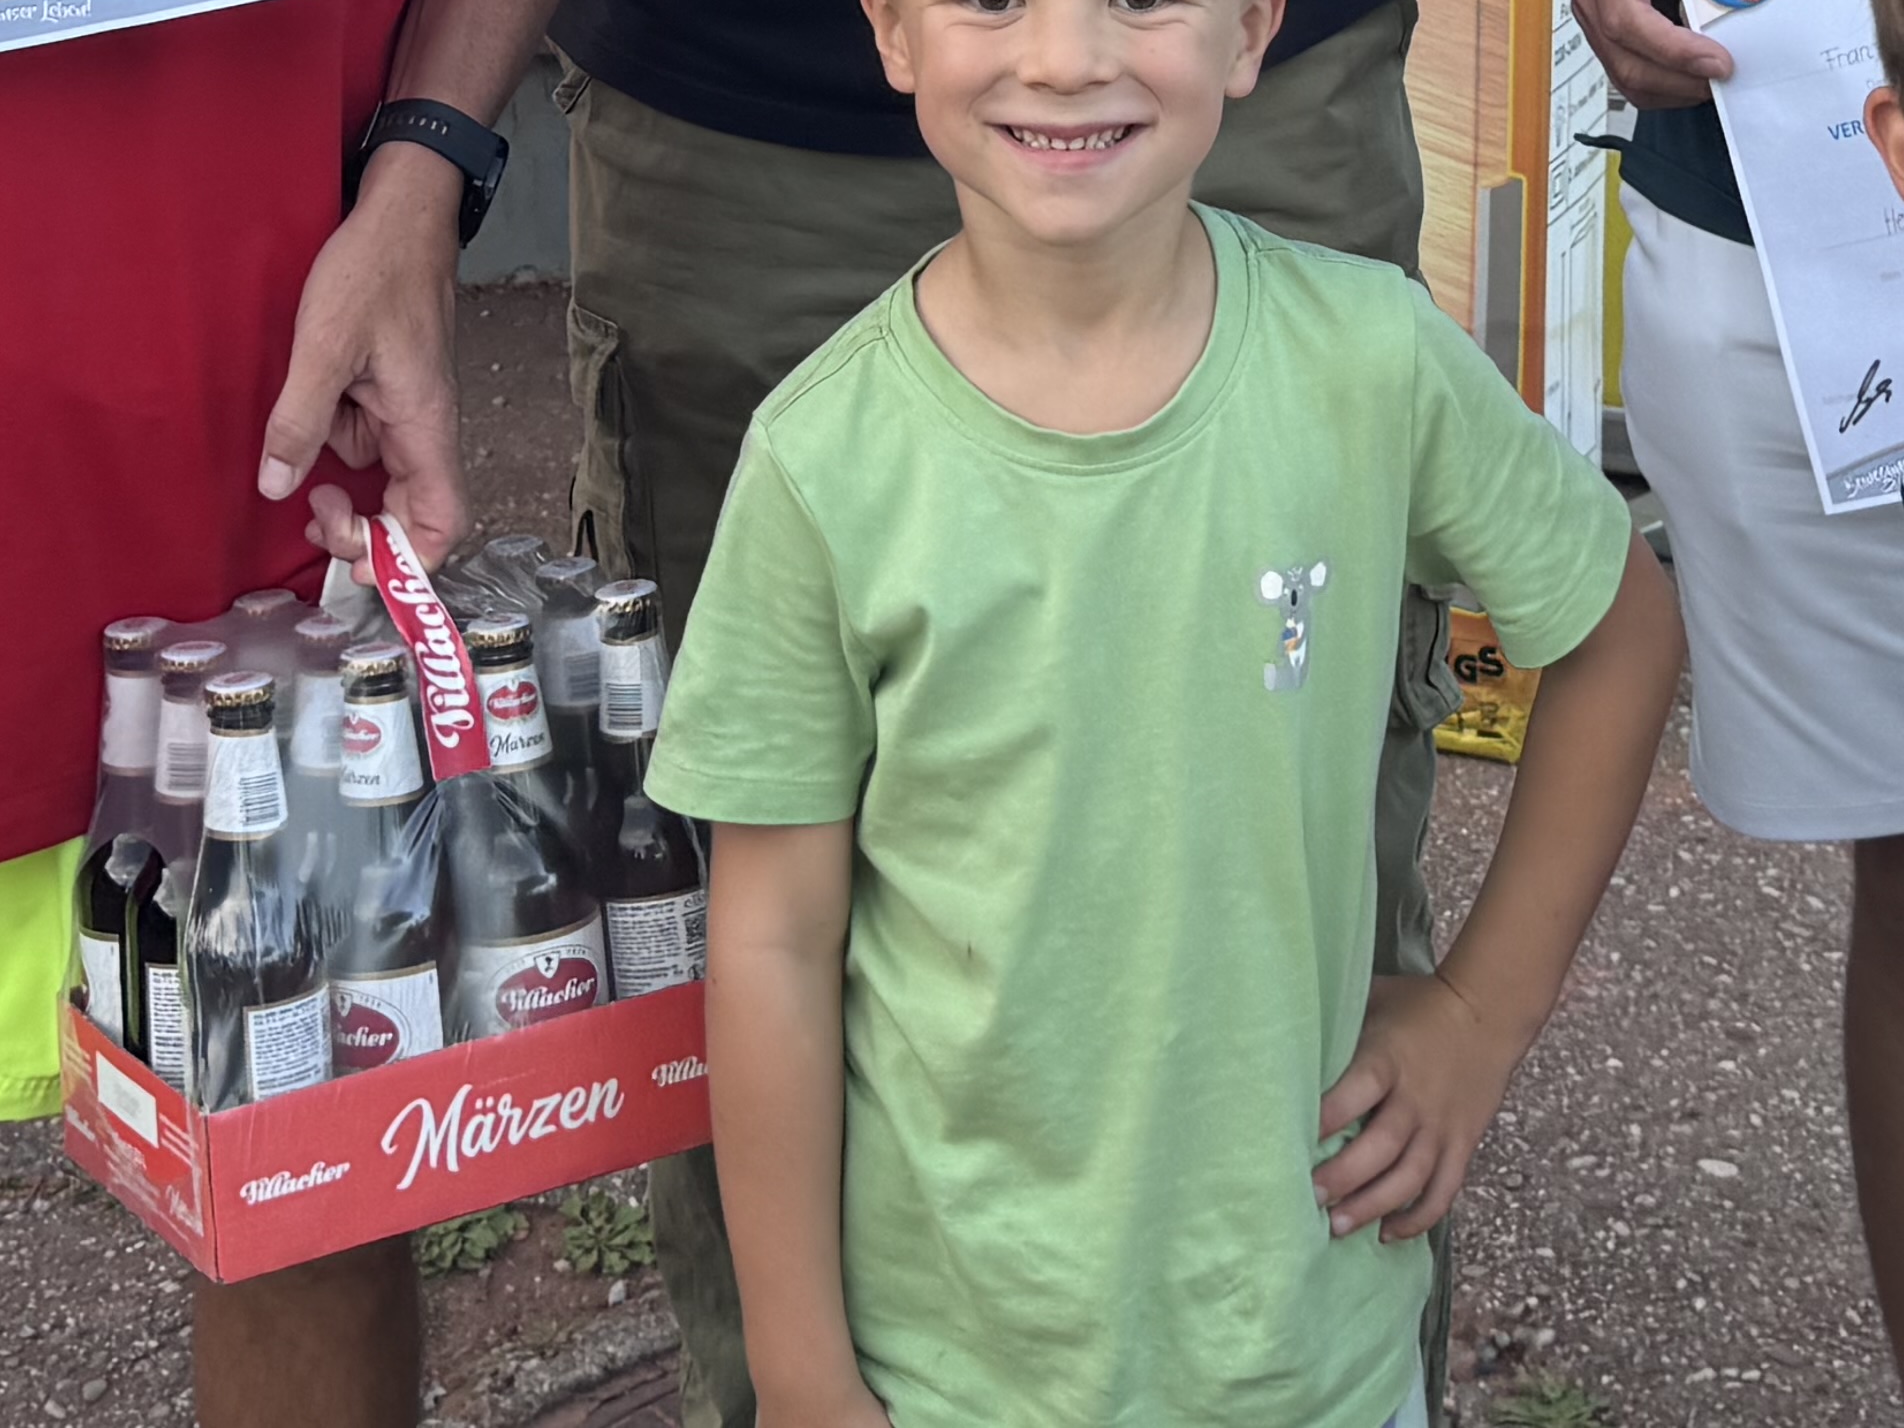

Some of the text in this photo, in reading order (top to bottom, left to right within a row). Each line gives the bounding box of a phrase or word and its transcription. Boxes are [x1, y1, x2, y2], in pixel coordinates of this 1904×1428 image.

[1819, 44, 1882, 72] Fran
[499, 976, 596, 1013] Villacher
[239, 1160, 351, 1206] Villacher
[380, 1076, 625, 1191] Märzen
